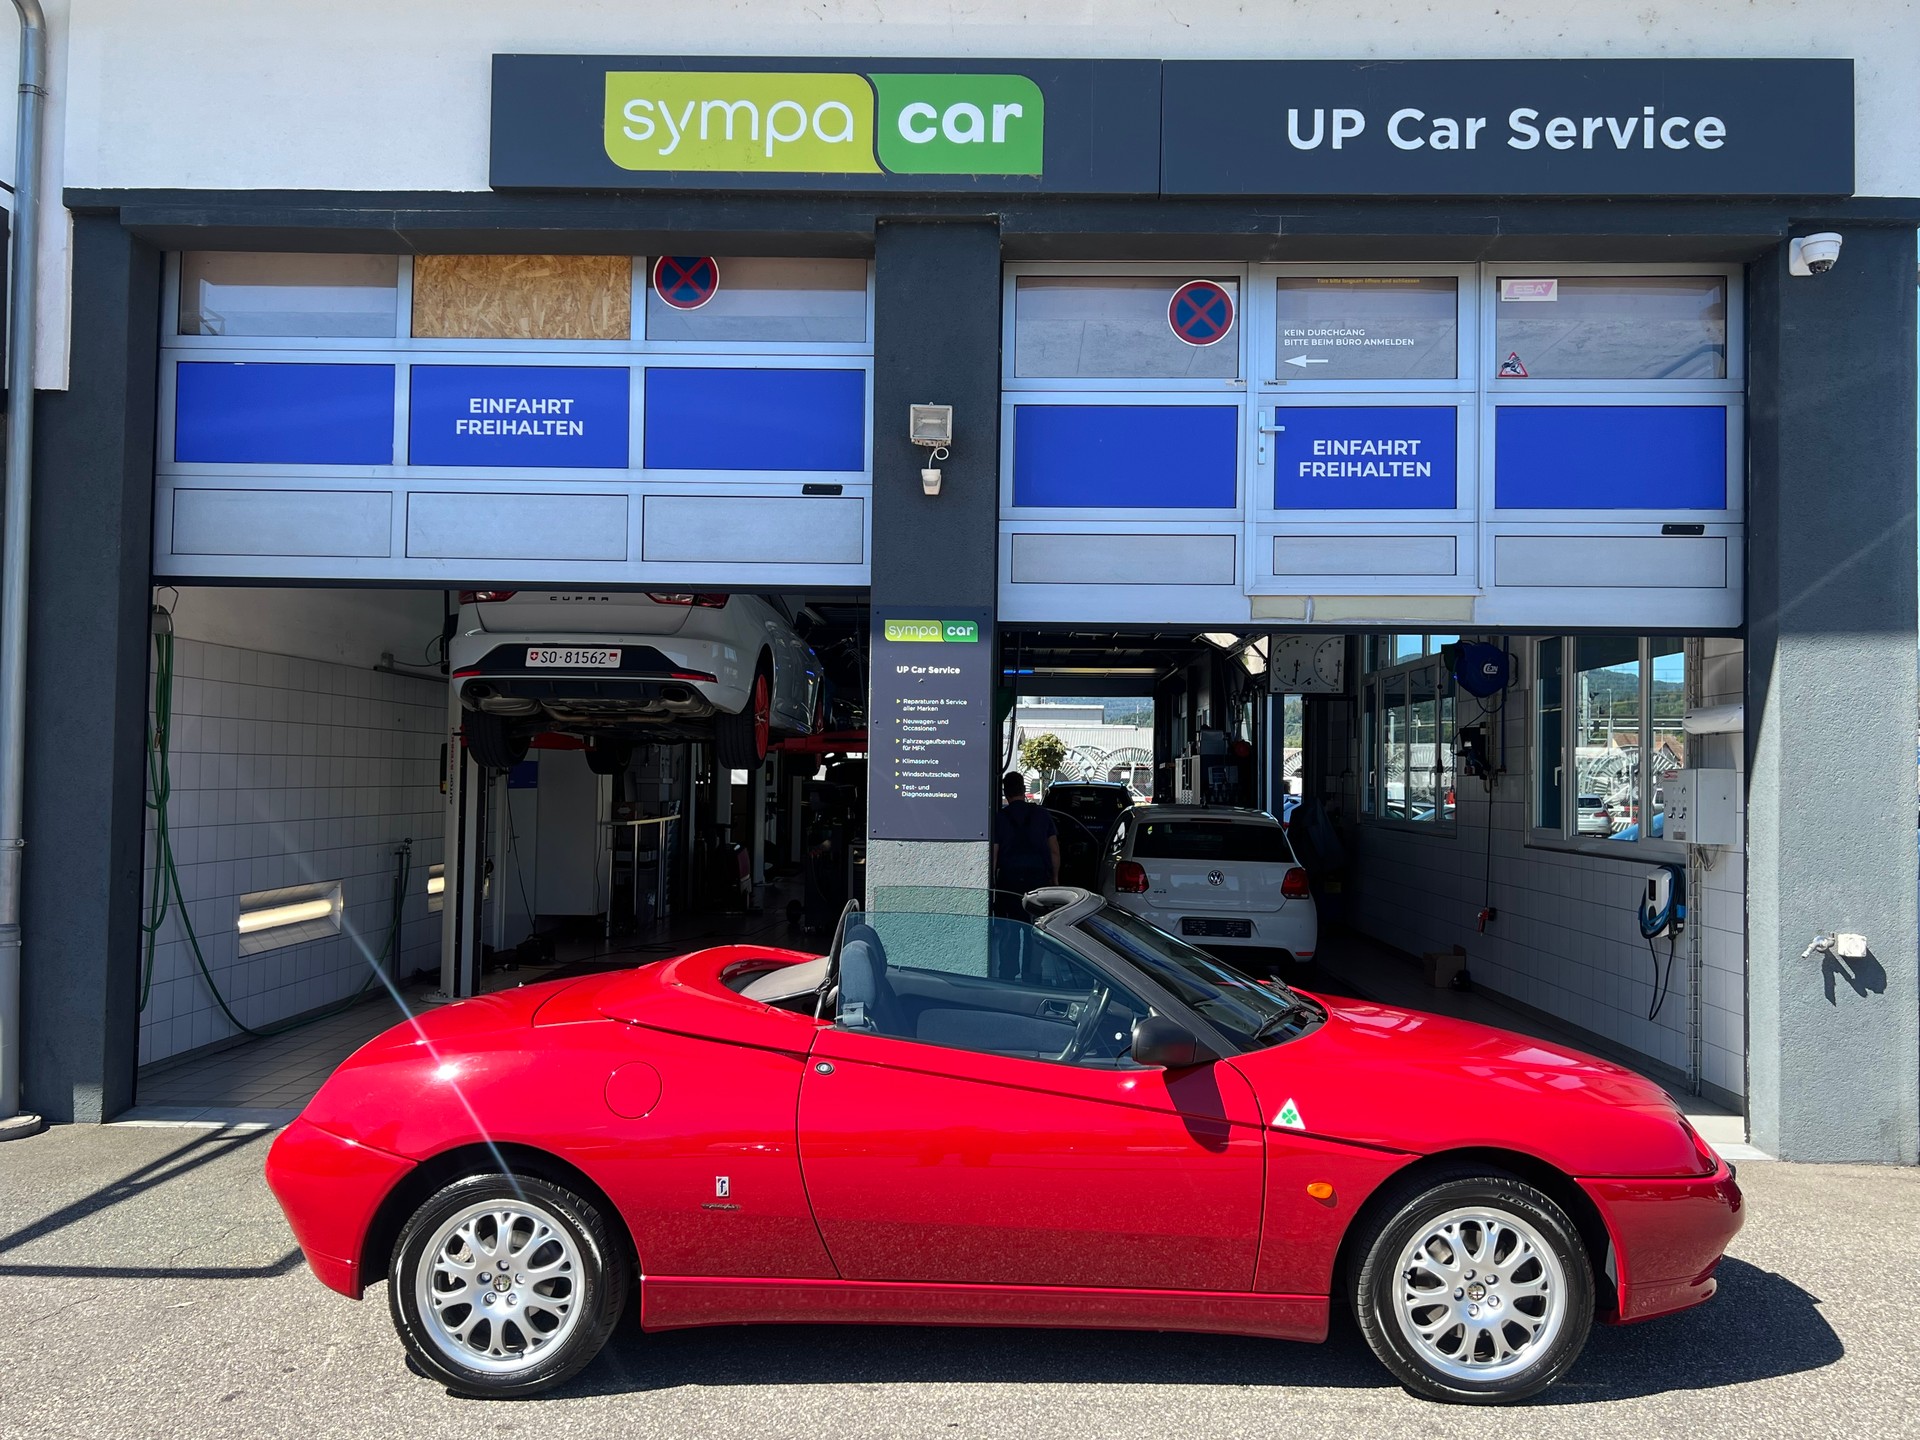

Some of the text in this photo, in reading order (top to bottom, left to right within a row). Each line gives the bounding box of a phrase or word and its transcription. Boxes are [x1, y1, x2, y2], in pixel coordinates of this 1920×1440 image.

[623, 99, 1022, 157] sympa car
[1288, 107, 1726, 150] UP Car Service
[1308, 329, 1365, 337] DURCHGANG
[1336, 337, 1361, 345] BÜRO
[470, 399, 574, 414] EINFAHRT
[457, 420, 583, 435] FREIHALTEN
[1314, 440, 1421, 455] EINFAHRT
[1300, 462, 1430, 477] FREIHALTEN
[888, 624, 974, 639] sympa car
[928, 666, 960, 674] Service
[903, 738, 965, 746] Fahrzeugaufbereitung
